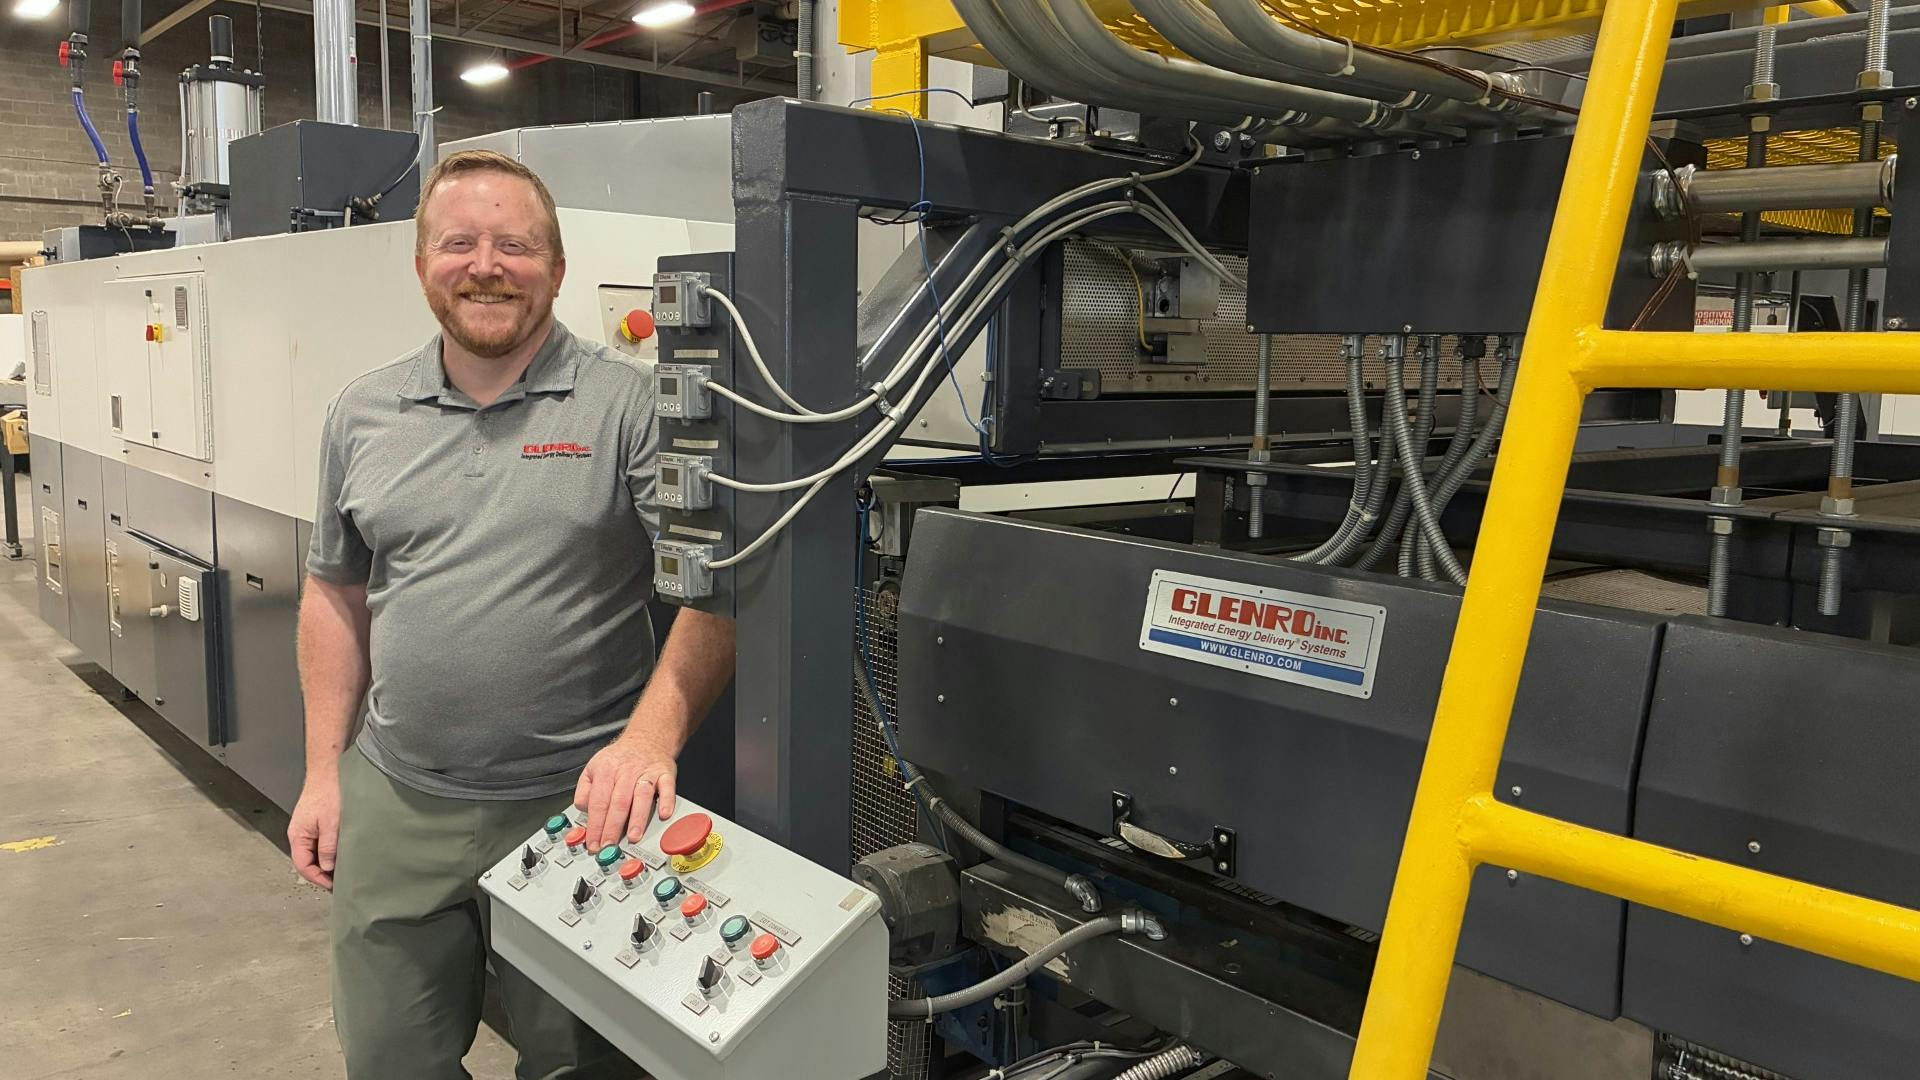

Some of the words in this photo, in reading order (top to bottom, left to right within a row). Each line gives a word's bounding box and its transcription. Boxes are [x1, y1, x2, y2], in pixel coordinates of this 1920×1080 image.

[1168, 614, 1216, 632] Integrated
[1216, 623, 1253, 642] Energy
[1299, 640, 1347, 659] Systems
[1200, 640, 1302, 671] WWW.GLENRO.COM
[672, 861, 690, 872] STOP
